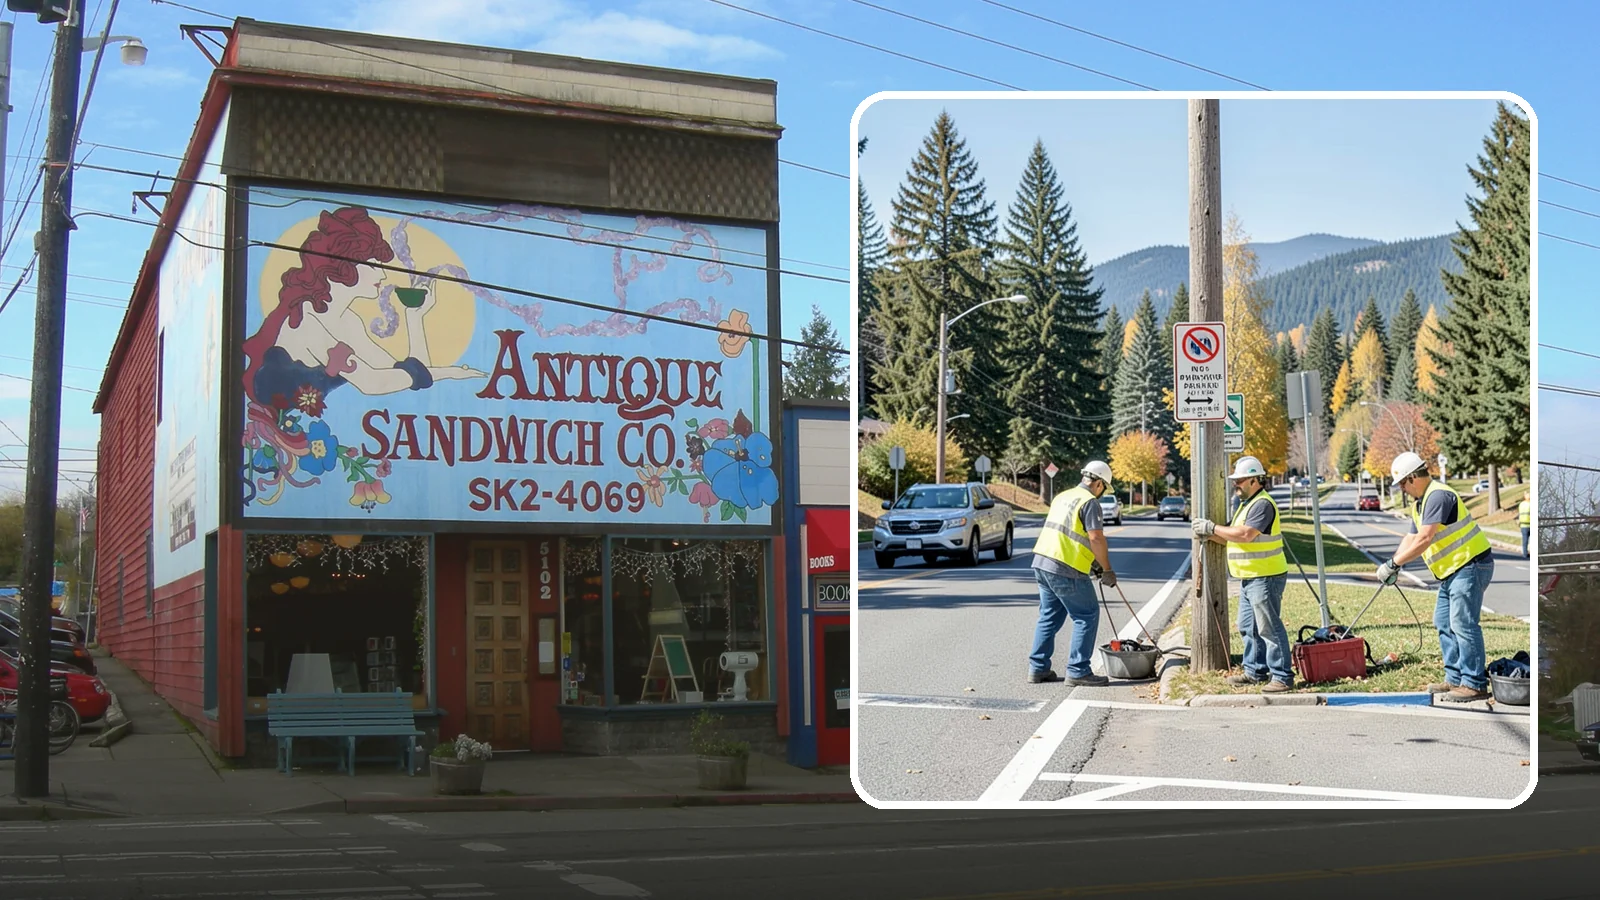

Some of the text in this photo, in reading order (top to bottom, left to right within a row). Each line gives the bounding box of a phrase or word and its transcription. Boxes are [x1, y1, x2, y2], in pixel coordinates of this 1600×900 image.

[476, 329, 723, 421] ANTIQUE
[361, 409, 685, 469] SANDWICH CO.
[468, 477, 645, 513] SK2-4069
[540, 541, 552, 600] 5102
[810, 555, 835, 569] BOOKS
